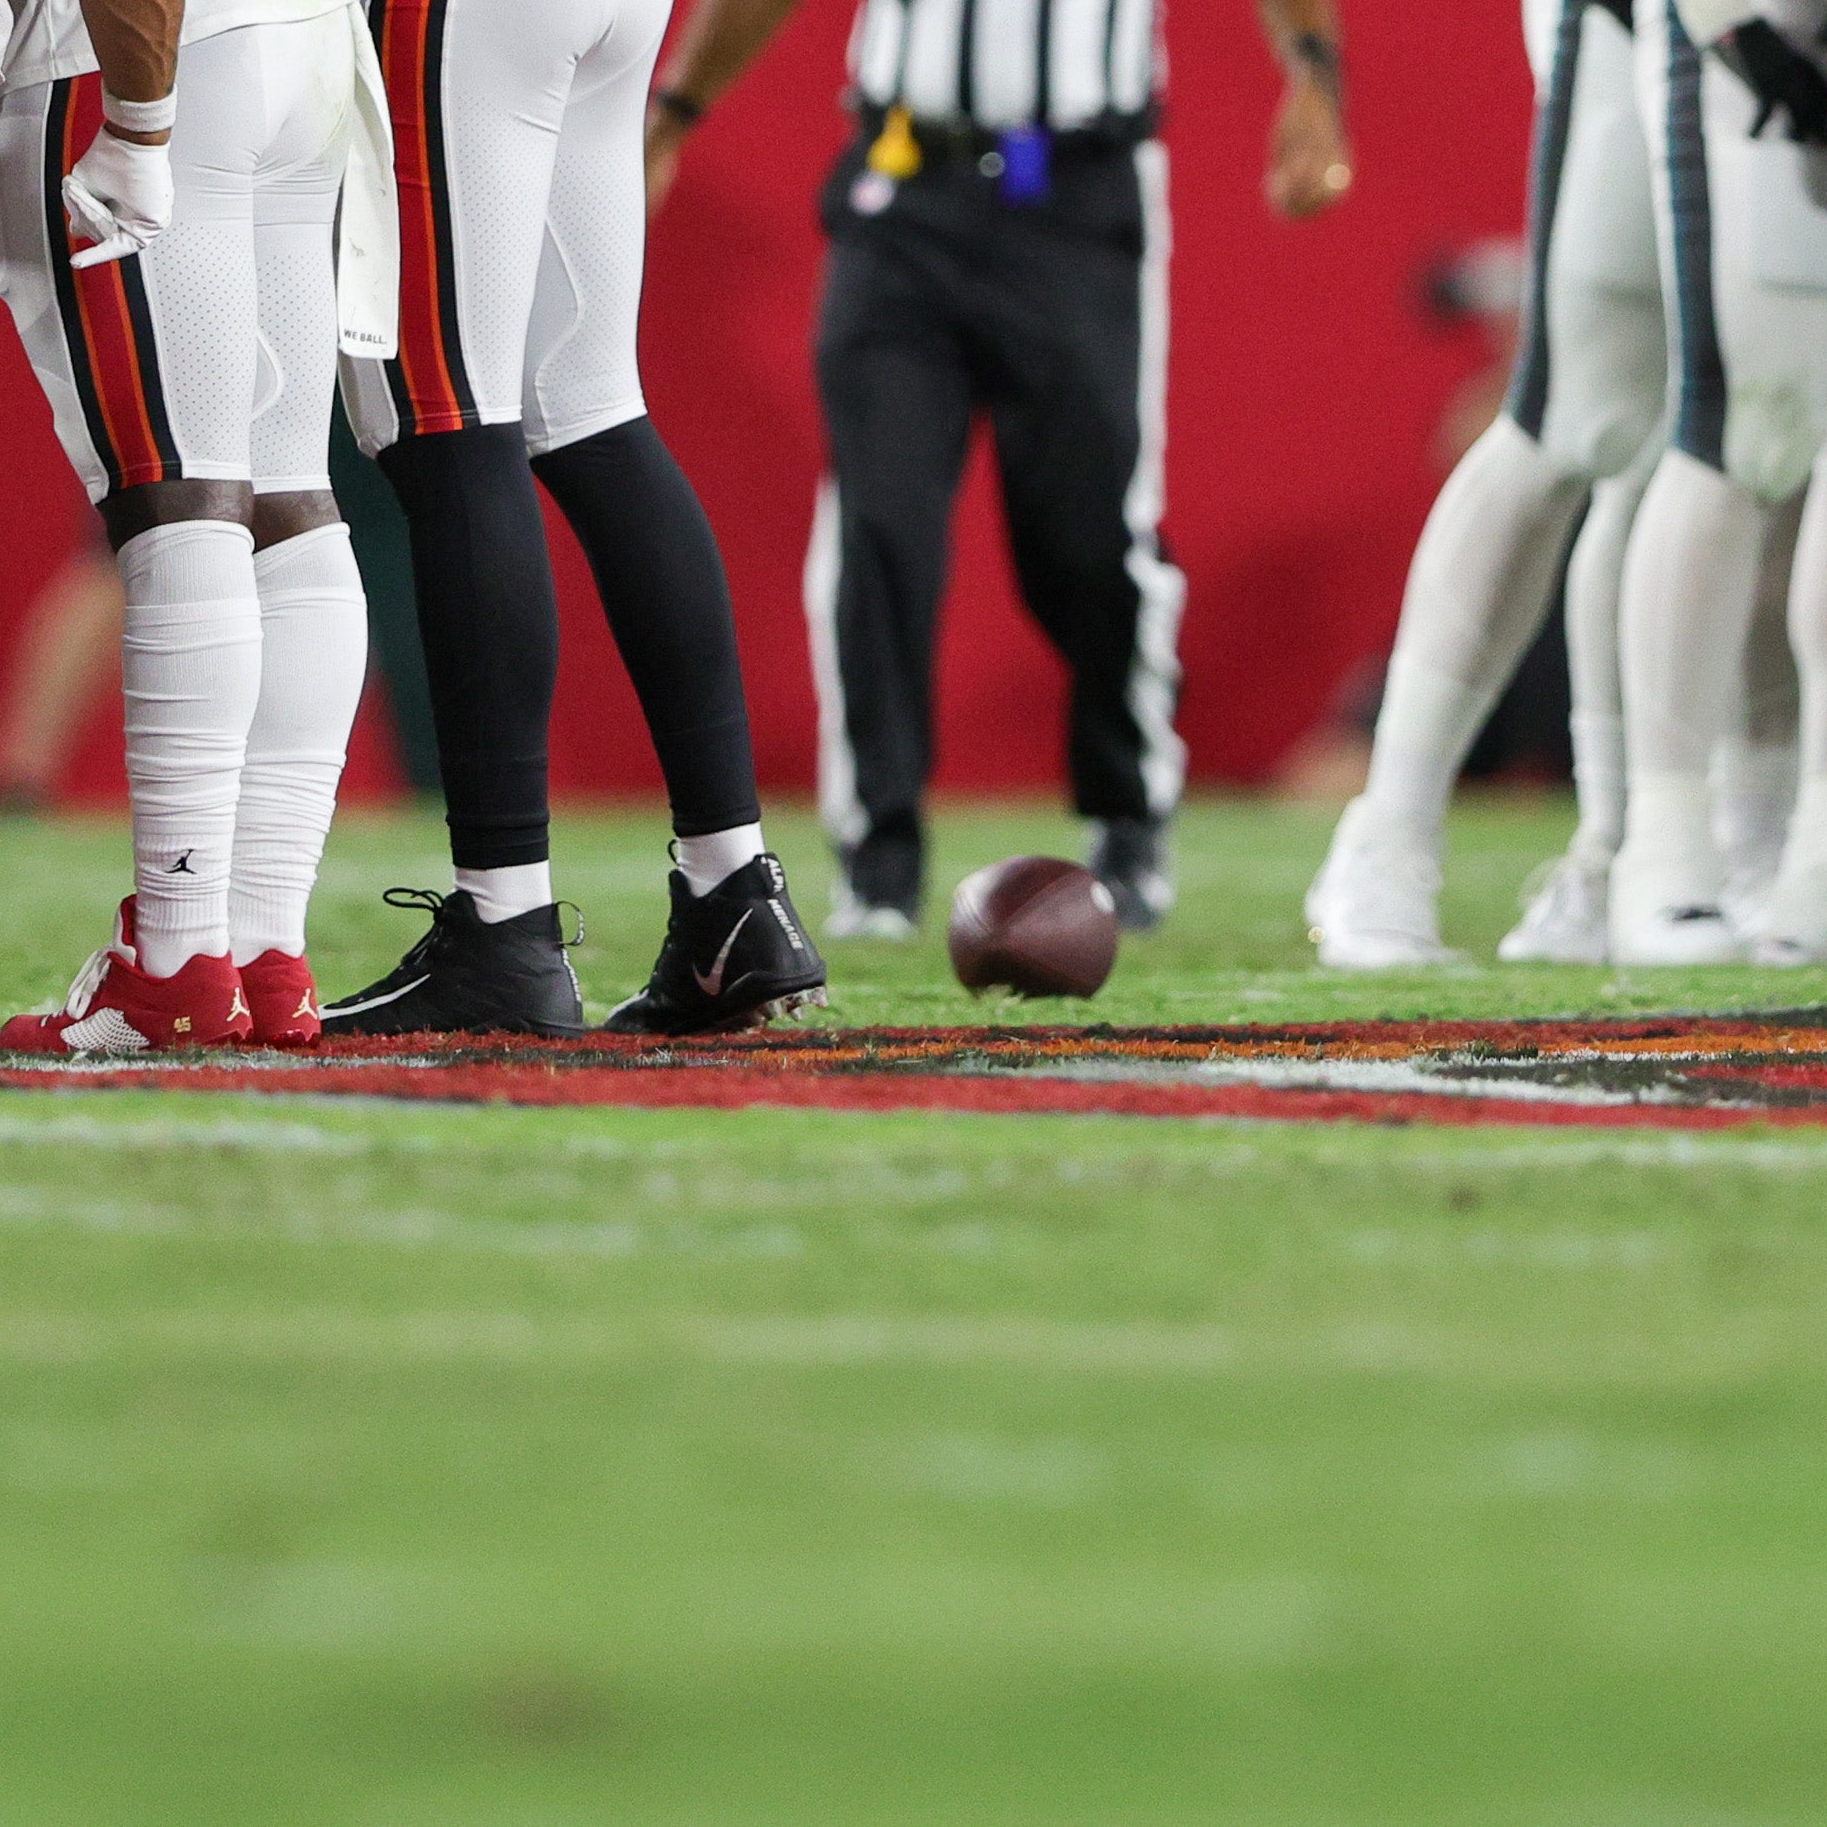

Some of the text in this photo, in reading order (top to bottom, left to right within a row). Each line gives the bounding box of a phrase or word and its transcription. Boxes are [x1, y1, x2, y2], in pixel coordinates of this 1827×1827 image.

[343, 328, 388, 345] WE BALL.
[766, 898, 805, 950] MENACE
[173, 1015, 192, 1034] 45
